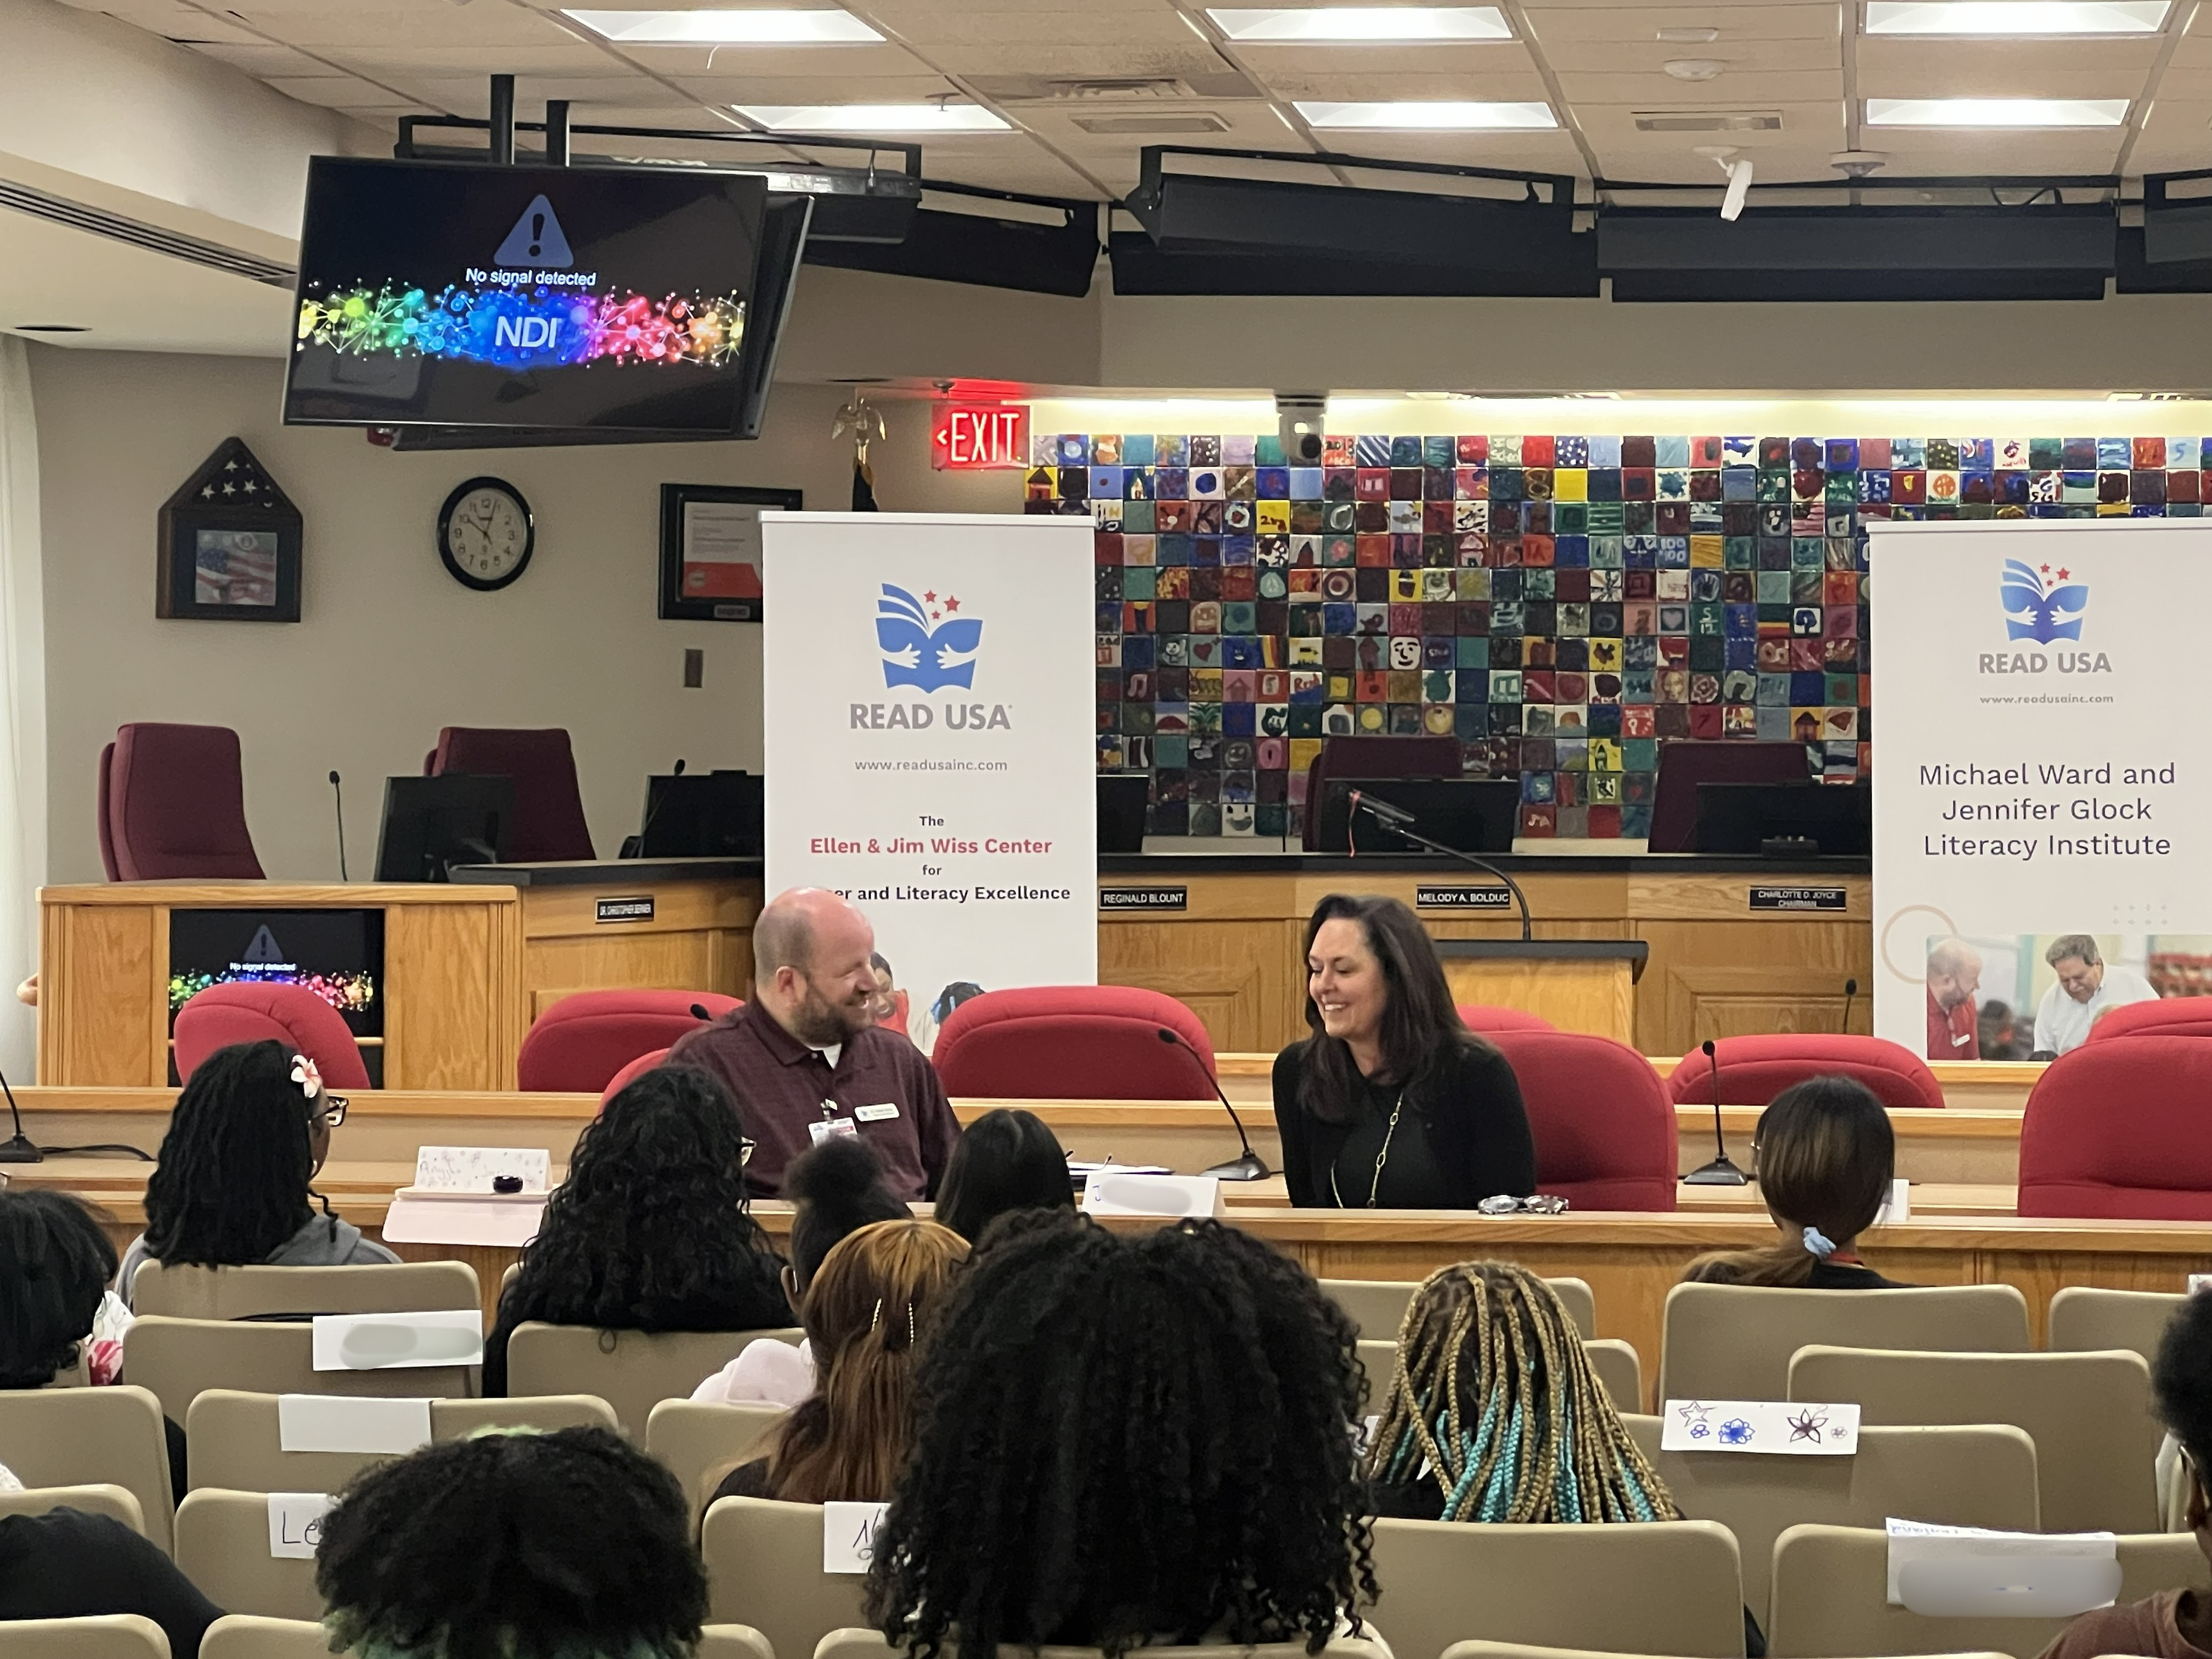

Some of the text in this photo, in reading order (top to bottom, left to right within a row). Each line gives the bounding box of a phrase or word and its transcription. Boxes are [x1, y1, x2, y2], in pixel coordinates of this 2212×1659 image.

[466, 268, 596, 286] No signal detected
[495, 316, 557, 348] NDI
[951, 413, 1019, 461] EXIT
[454, 528, 462, 538] 9
[508, 531, 515, 540] 3
[469, 555, 475, 566] 7
[480, 560, 488, 570] 6
[1979, 653, 2112, 673] READ USA
[1980, 693, 2113, 703] www.readusainc.com
[850, 703, 1011, 730] READ USA
[855, 759, 1007, 770] www.readusainc.com
[1921, 763, 2174, 785] Michael Ward and
[1943, 798, 2152, 820] Jennifer Glock
[919, 816, 944, 826] The
[811, 838, 1052, 853] Ellen & Jim Wiss Center
[1926, 833, 2170, 861] Literacy Institute
[923, 865, 941, 875] for
[858, 887, 889, 900] and
[896, 886, 968, 903] Literacy
[975, 886, 1070, 899] Excellence
[1104, 894, 1183, 903] REGINALD BLOUNT
[1418, 894, 1458, 902] MELODY
[1470, 893, 1509, 902] BOLDUC
[242, 963, 263, 972] signal
[264, 963, 296, 971] detected
